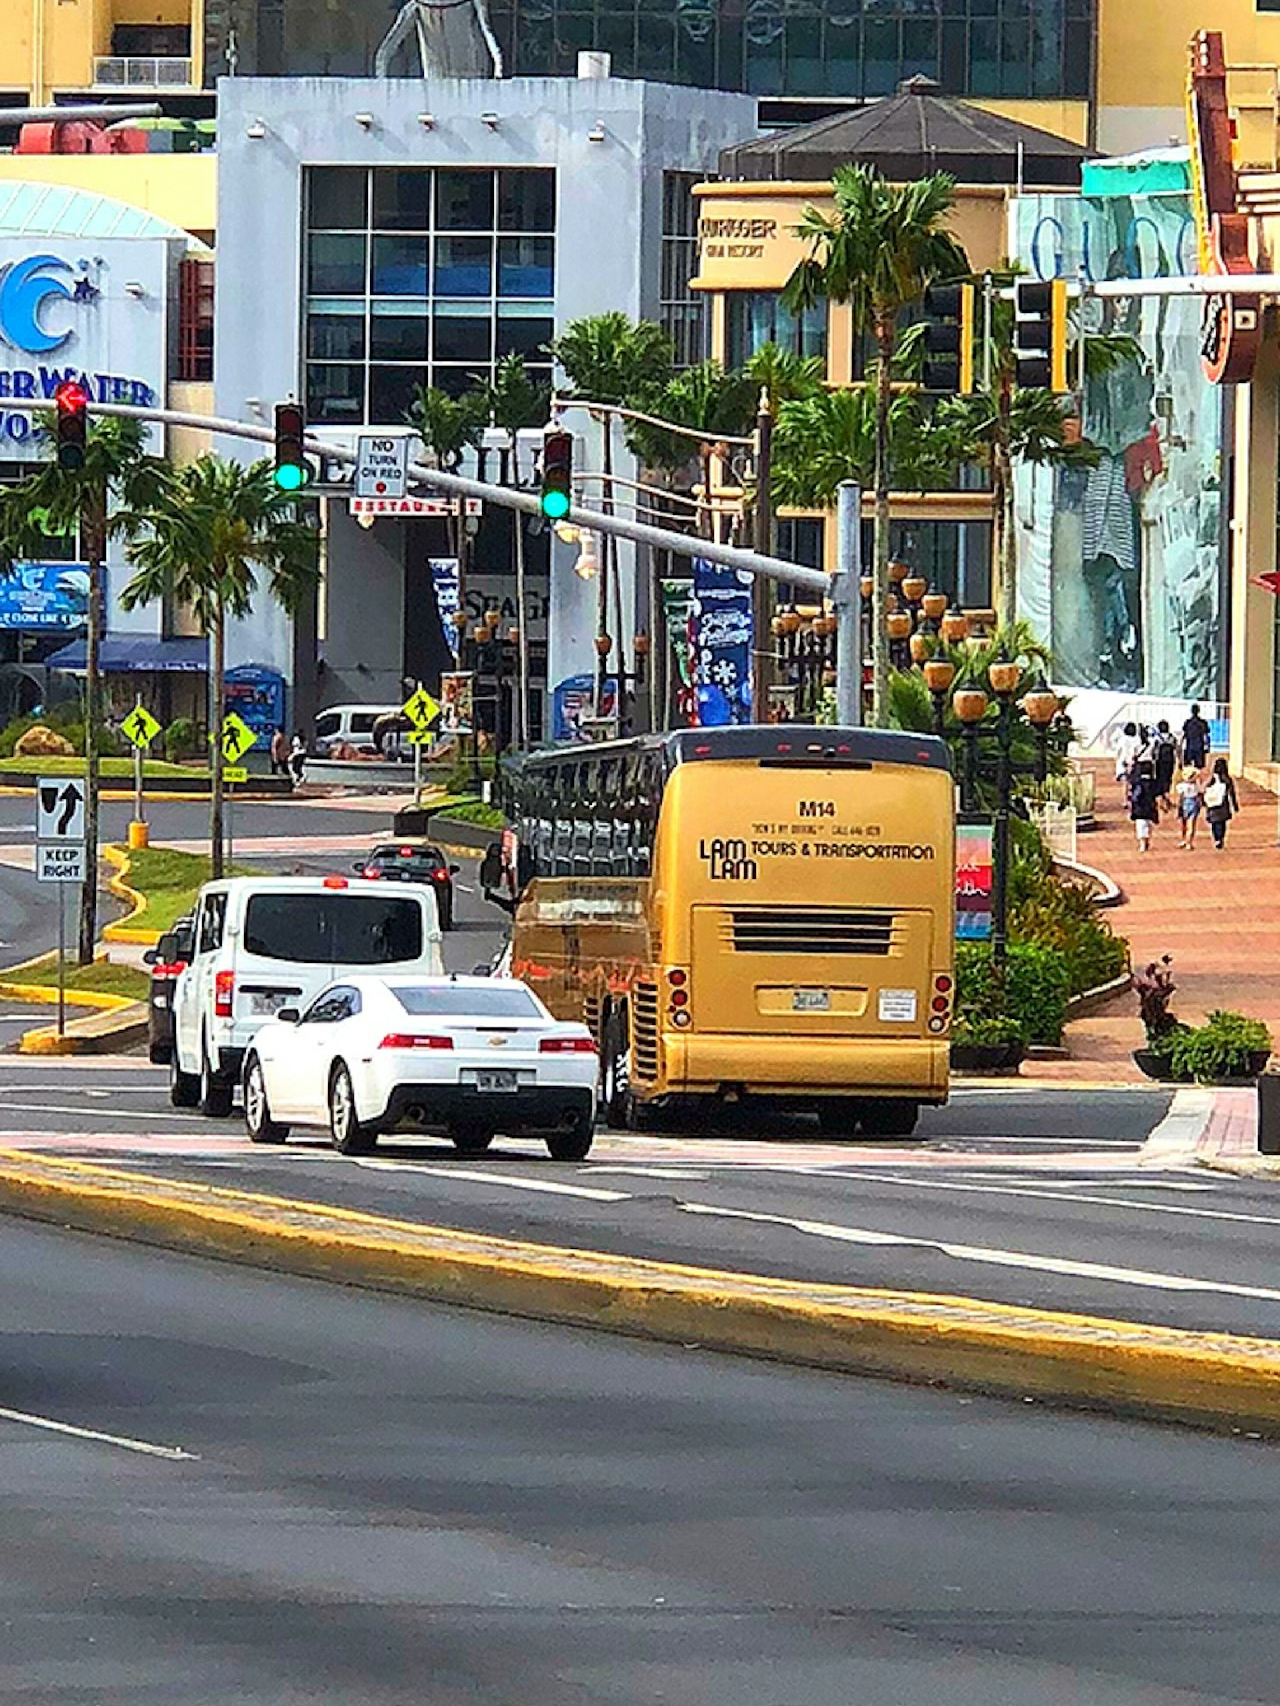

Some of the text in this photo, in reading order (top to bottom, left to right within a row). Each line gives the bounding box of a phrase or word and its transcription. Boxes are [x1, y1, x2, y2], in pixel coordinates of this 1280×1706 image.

[372, 440, 394, 452] NO
[369, 455, 397, 466] TURN
[361, 467, 402, 479] ON RED
[799, 801, 836, 817] M14
[46, 849, 79, 862] KEEP
[700, 839, 935, 860] LAM TOURS & TRANSPORTATION
[44, 865, 80, 877] RIGHT
[711, 858, 757, 880] LAM
